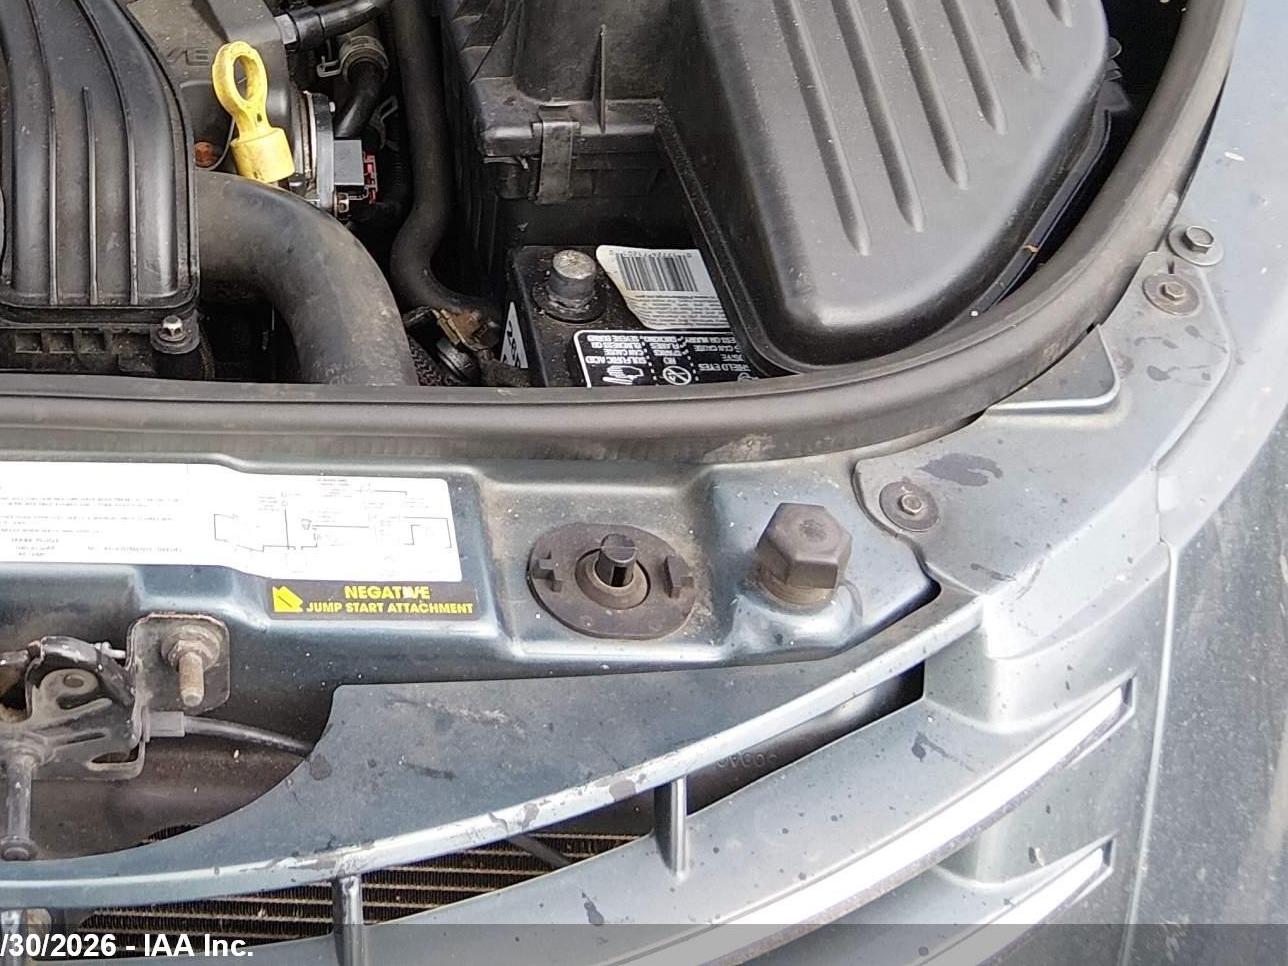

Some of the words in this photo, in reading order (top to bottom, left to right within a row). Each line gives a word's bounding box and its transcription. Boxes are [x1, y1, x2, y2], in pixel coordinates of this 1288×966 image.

[585, 355, 605, 364] ACID
[605, 356, 648, 364] SULFURIC
[306, 602, 342, 613] JUMP
[345, 603, 385, 613] START
[387, 603, 473, 614] ATTACHMENT
